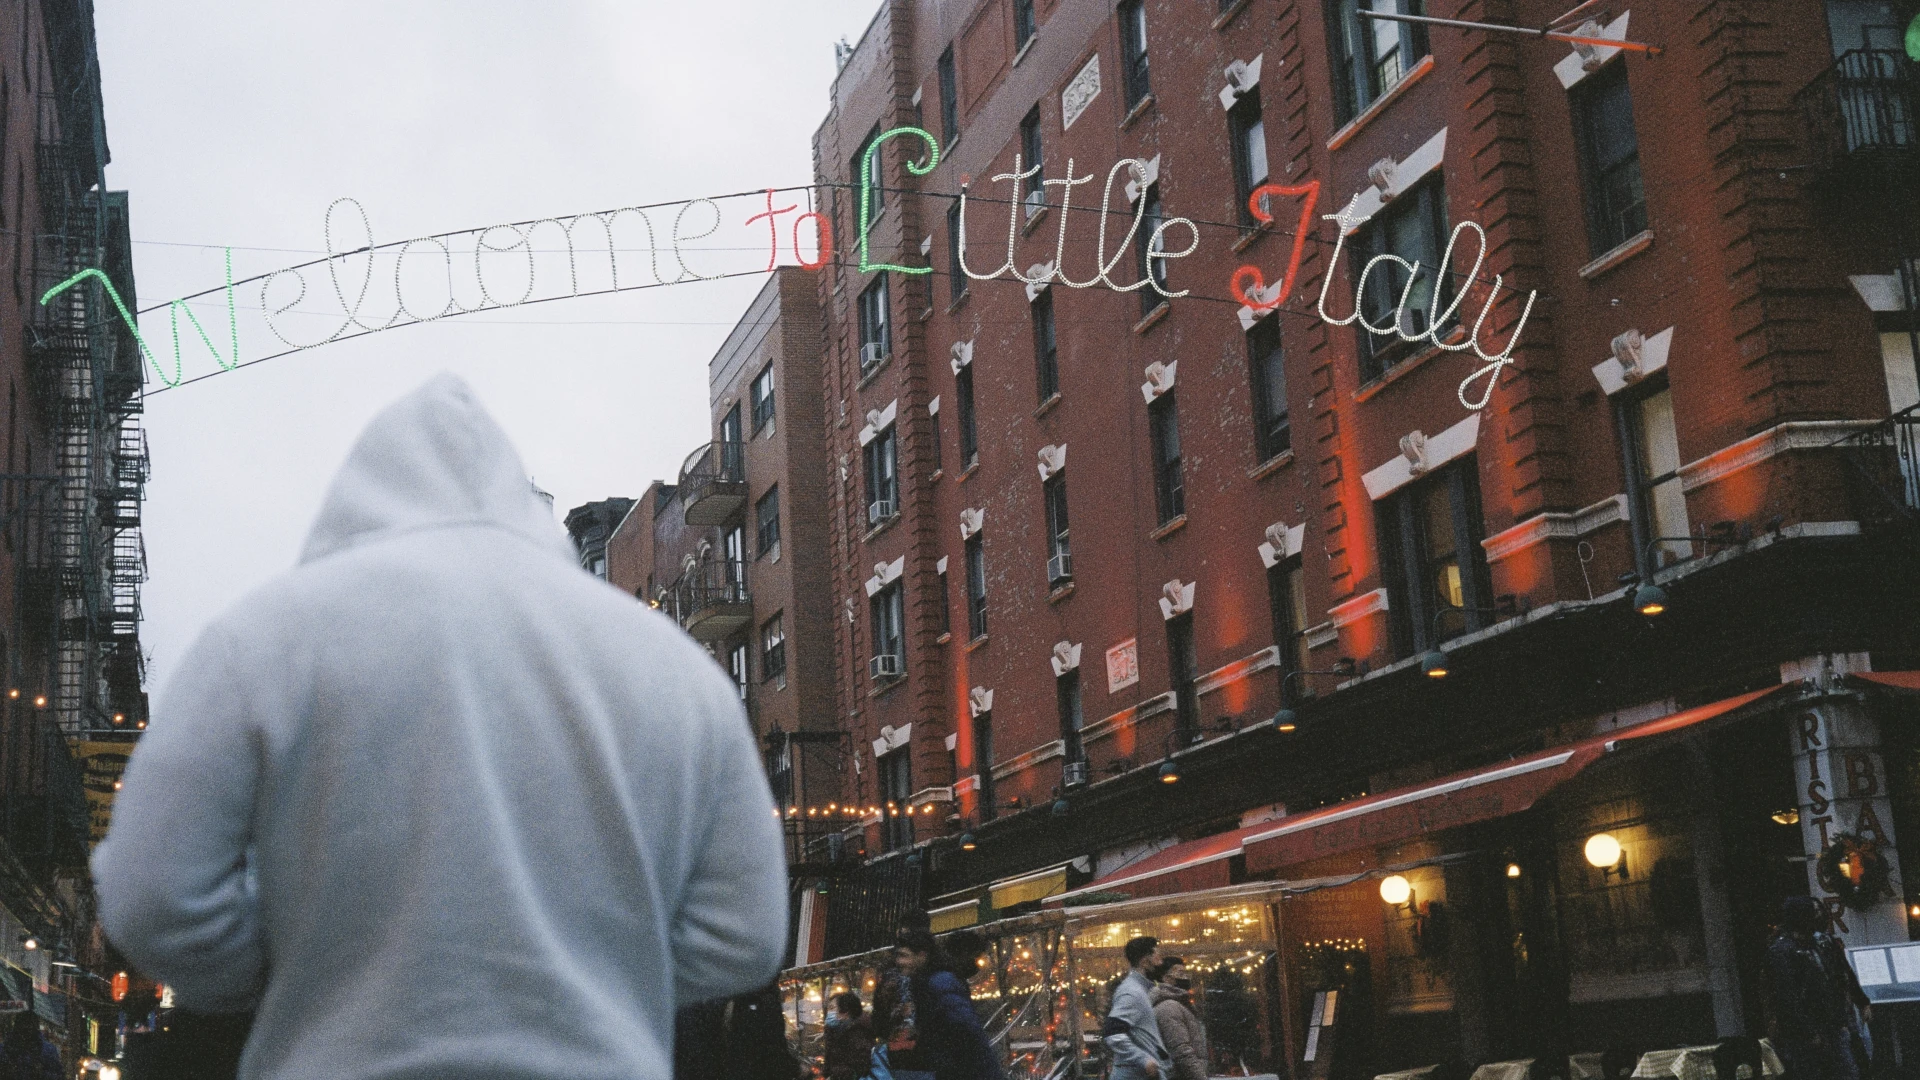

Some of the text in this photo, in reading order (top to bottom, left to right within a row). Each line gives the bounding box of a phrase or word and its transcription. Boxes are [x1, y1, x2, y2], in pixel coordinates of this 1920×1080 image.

[40, 126, 1538, 410] Welcome to Little Italy
[1801, 711, 1850, 946] RISTOR
[1844, 751, 1898, 897] BA
